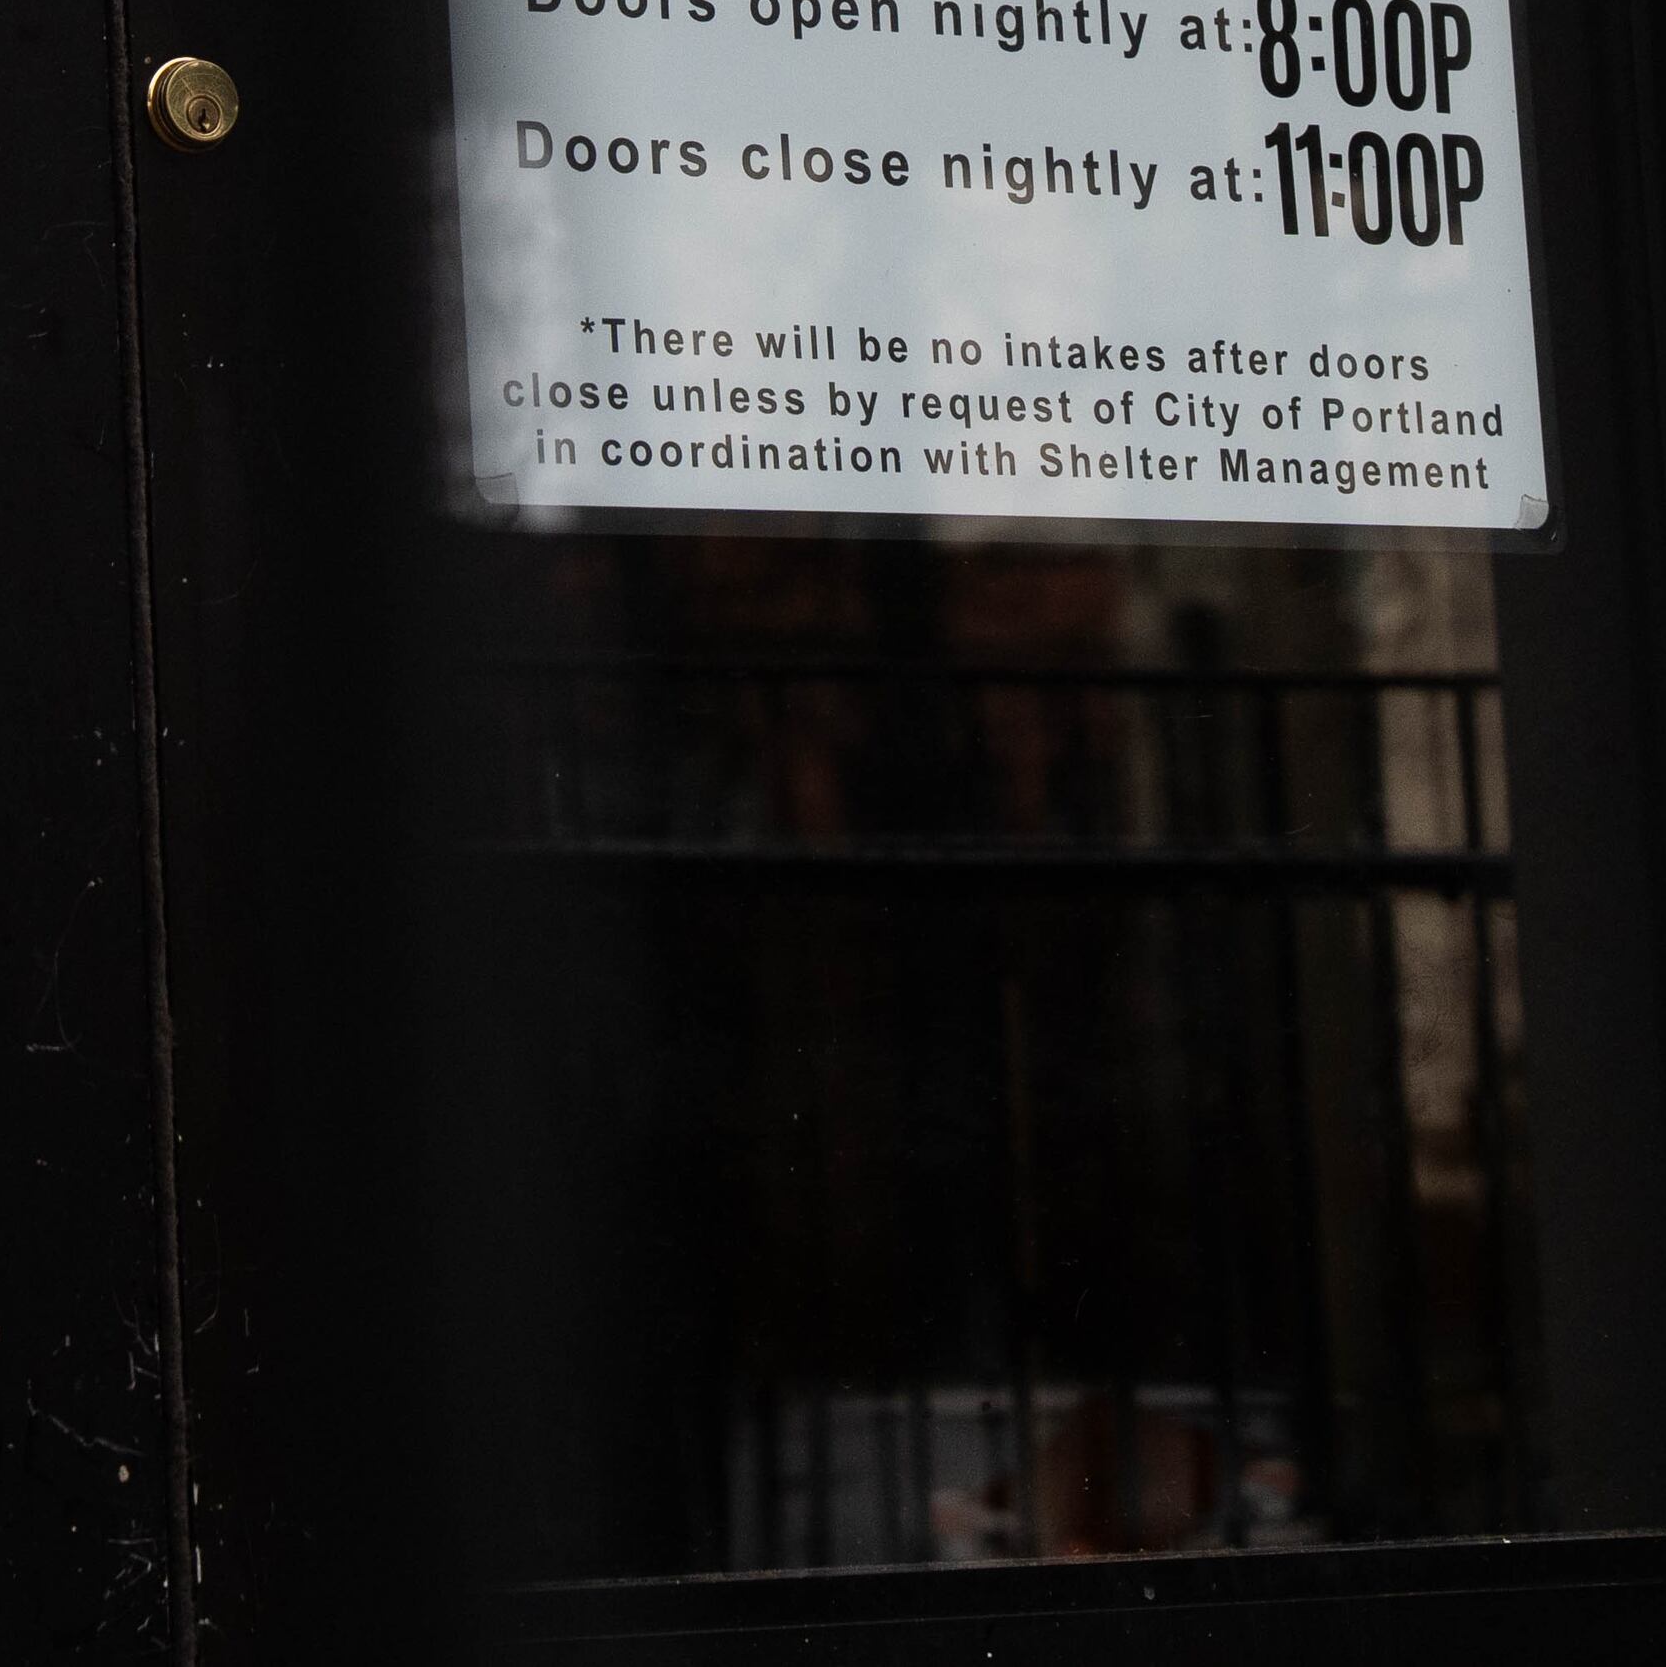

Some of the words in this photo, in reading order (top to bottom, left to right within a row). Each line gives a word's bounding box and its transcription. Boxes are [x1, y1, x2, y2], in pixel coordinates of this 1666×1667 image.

[1181, 8, 1251, 52] at:
[517, 121, 707, 176] Doors
[742, 134, 909, 186] close
[944, 144, 1157, 210] nightly
[1191, 158, 1262, 202] at:
[1265, 122, 1484, 247] 11:00P
[756, 325, 834, 360] will
[859, 328, 907, 362] be
[933, 339, 981, 365] no
[1005, 333, 1165, 371] intakes
[1189, 340, 1287, 375] after
[1310, 344, 1428, 380] doors
[502, 375, 627, 409] close
[654, 378, 804, 414] unless
[829, 382, 877, 426] by
[903, 391, 1071, 428] request
[1094, 391, 1133, 424] of
[1156, 392, 1239, 436] City
[1263, 396, 1301, 429] of
[1323, 398, 1502, 436] Portland
[537, 430, 575, 464] in
[602, 435, 901, 472] coordination
[924, 441, 1015, 475] with
[1041, 443, 1197, 480] Shelter
[1220, 449, 1488, 494] Management
